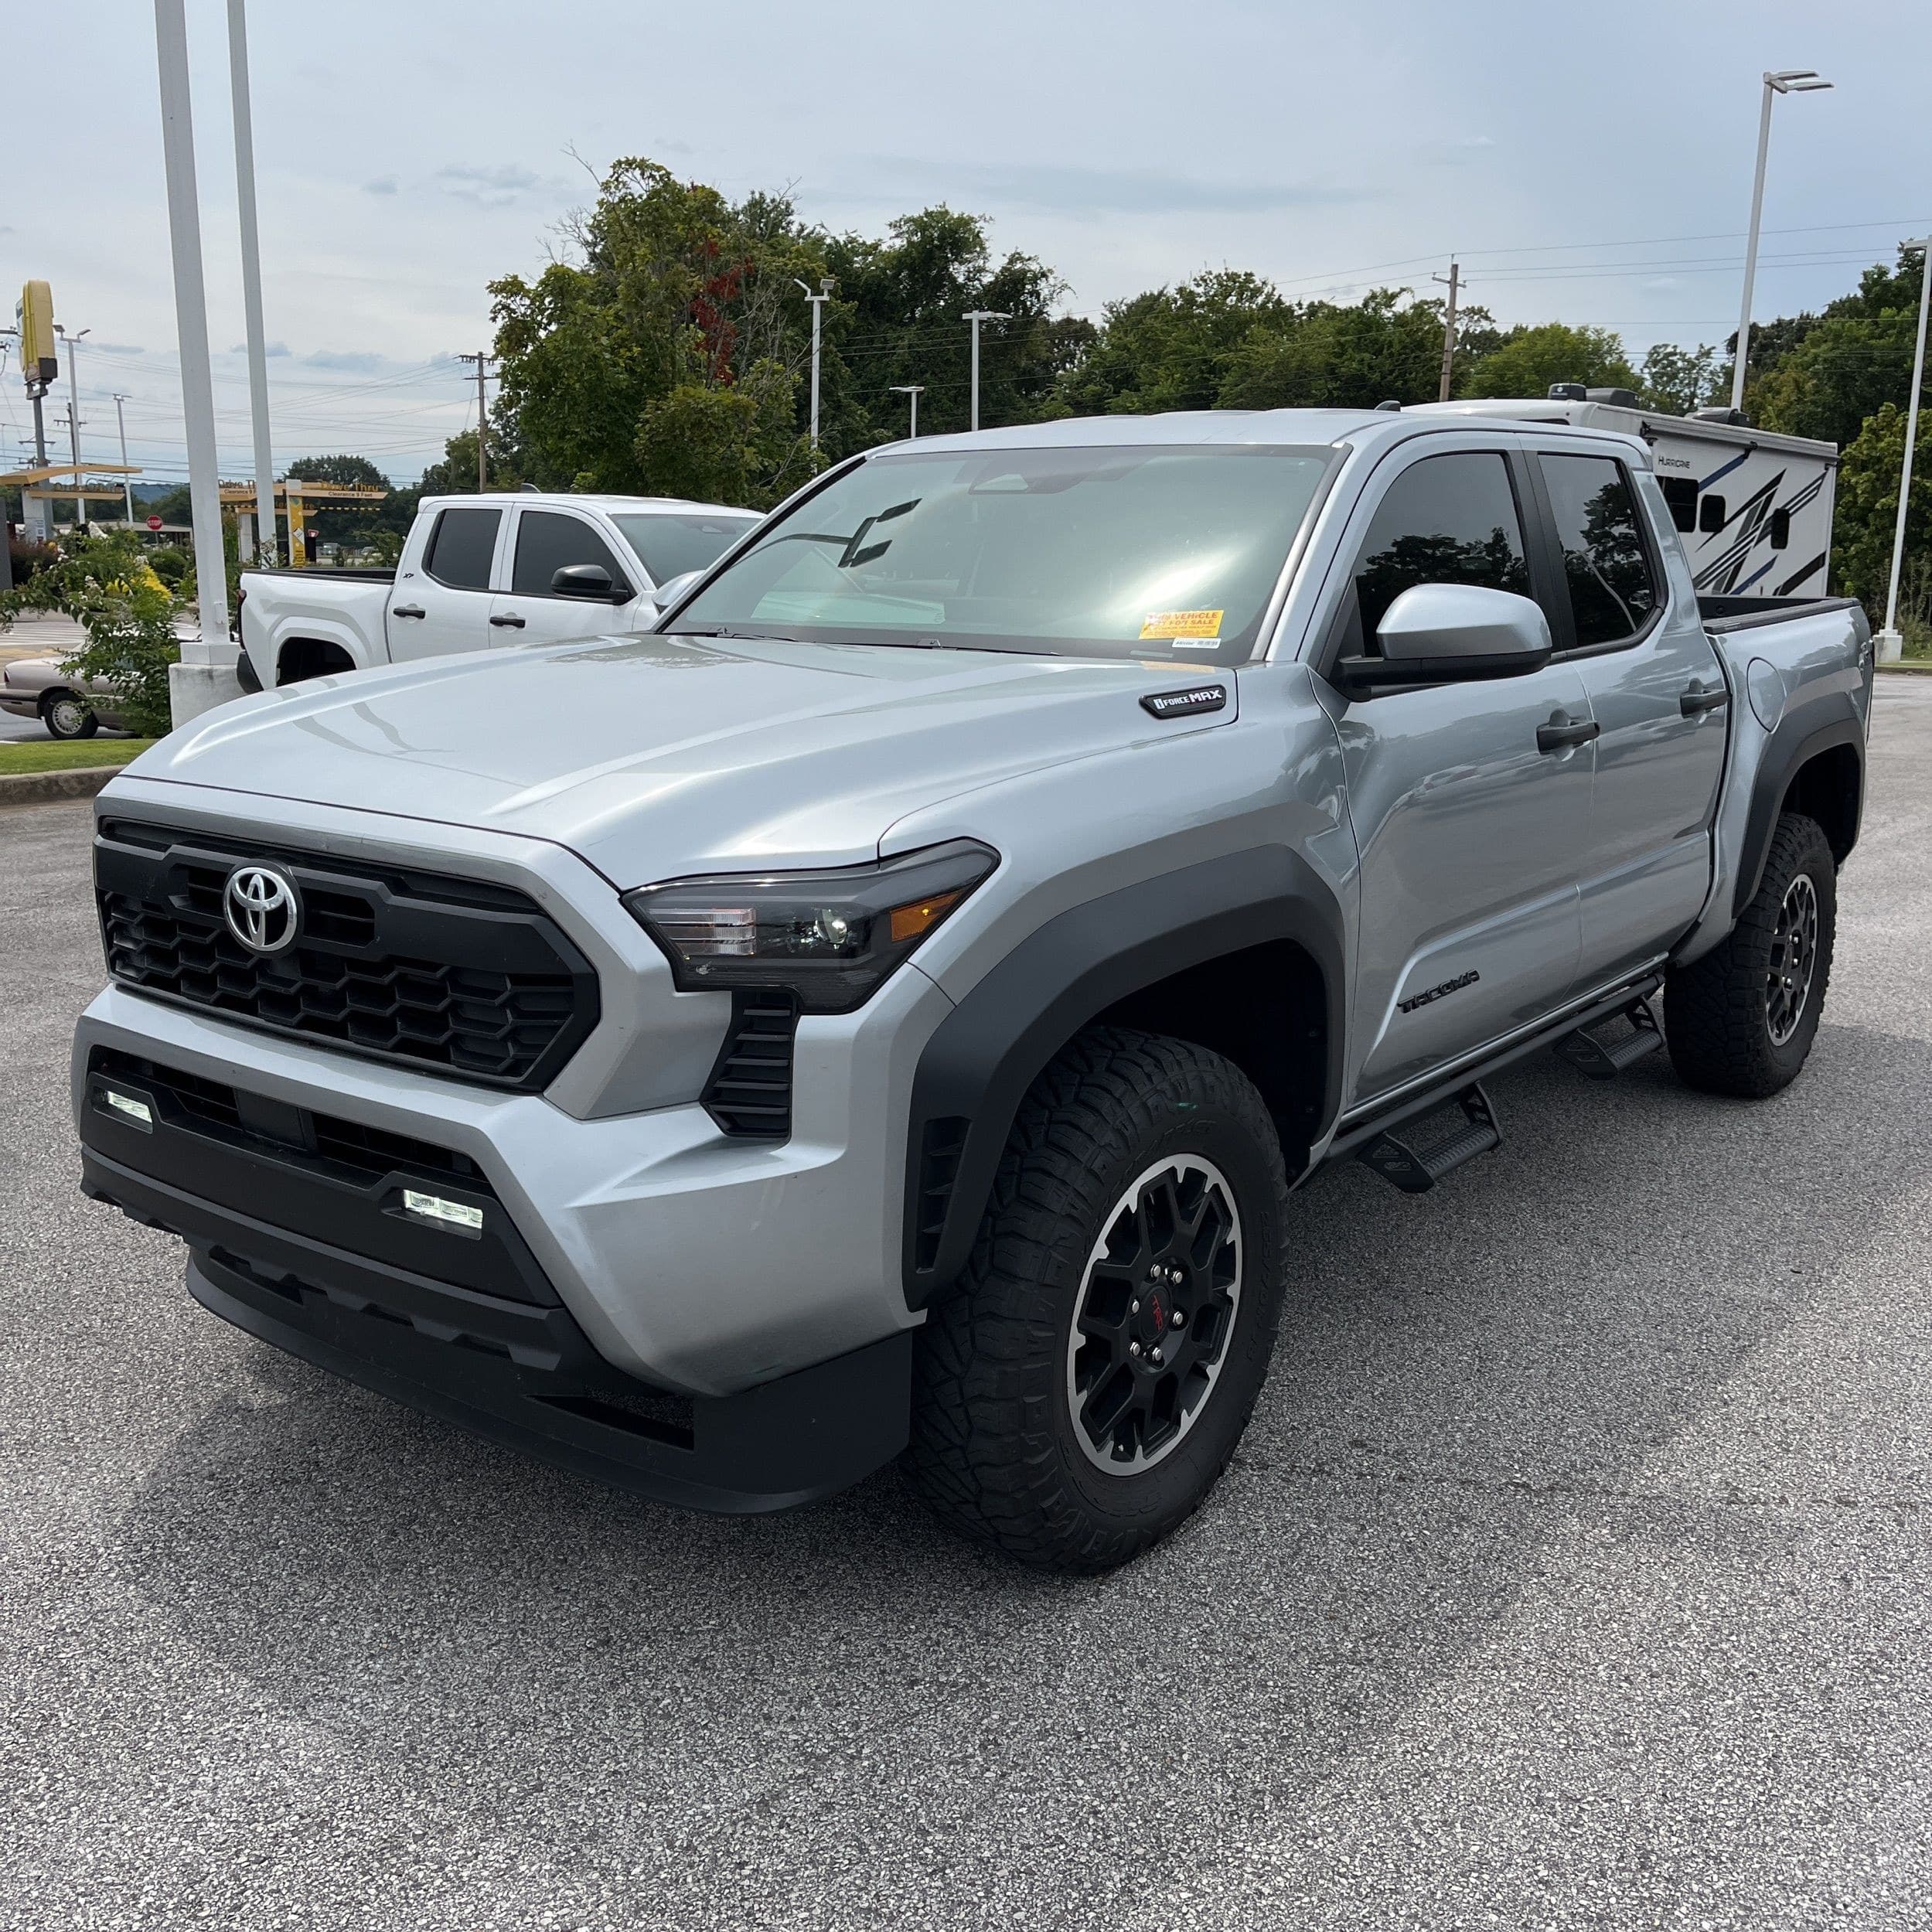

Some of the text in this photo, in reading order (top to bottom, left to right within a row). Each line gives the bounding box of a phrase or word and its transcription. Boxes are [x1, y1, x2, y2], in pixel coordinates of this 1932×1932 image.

[356, 482, 379, 492] Thru
[1188, 690, 1222, 703] MAX
[1397, 969, 1481, 1014] TACOMA
